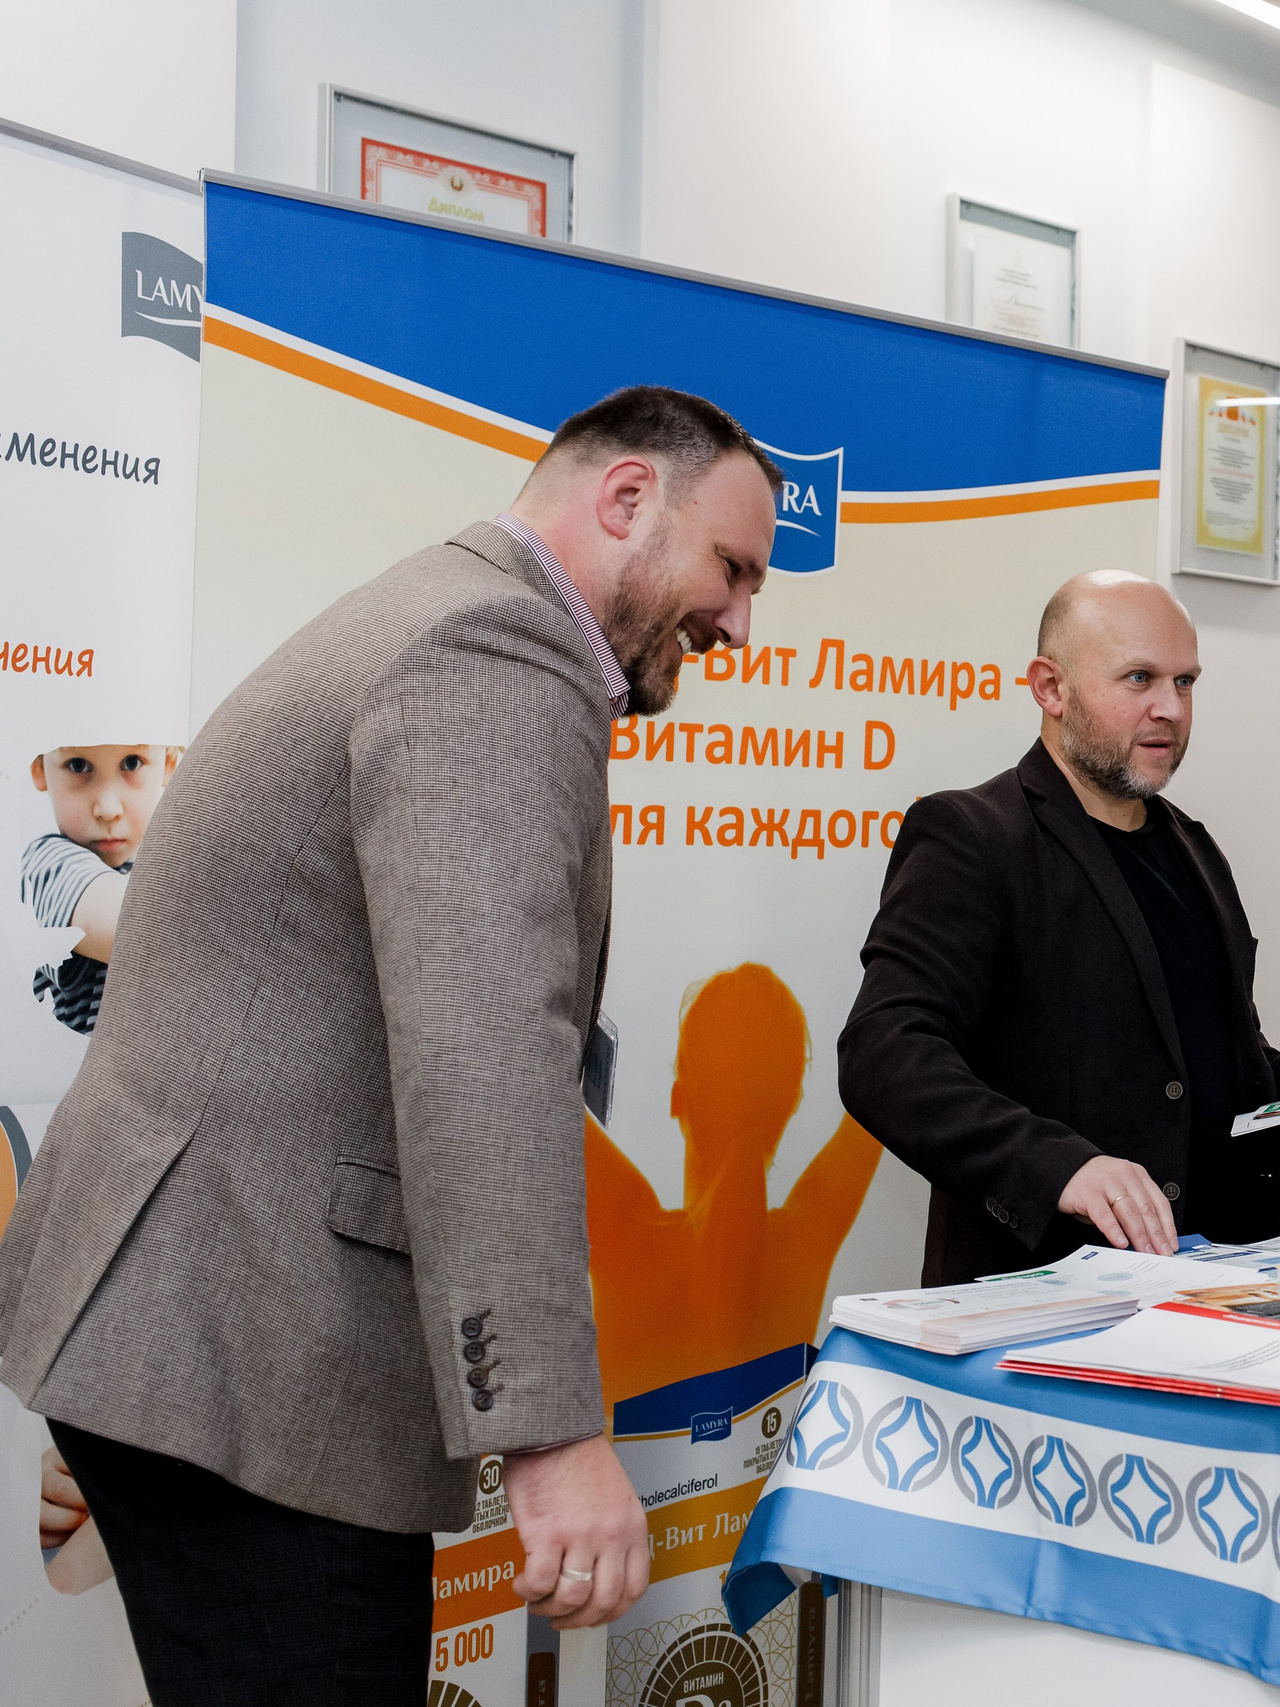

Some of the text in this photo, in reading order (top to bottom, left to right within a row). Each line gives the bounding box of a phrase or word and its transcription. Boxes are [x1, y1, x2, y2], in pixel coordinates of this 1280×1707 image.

[0, 432, 160, 485] менения
[673, 640, 797, 692] -Вит
[809, 638, 1001, 711] Ламира
[609, 713, 896, 770] Витамин D
[685, 805, 904, 860] каждого
[695, 1417, 728, 1433] LAMYRA
[766, 1412, 777, 1434] 15
[483, 1465, 500, 1490] 30
[638, 1473, 718, 1507] holecalciferol
[683, 1671, 724, 1693] ВИТАМИН
